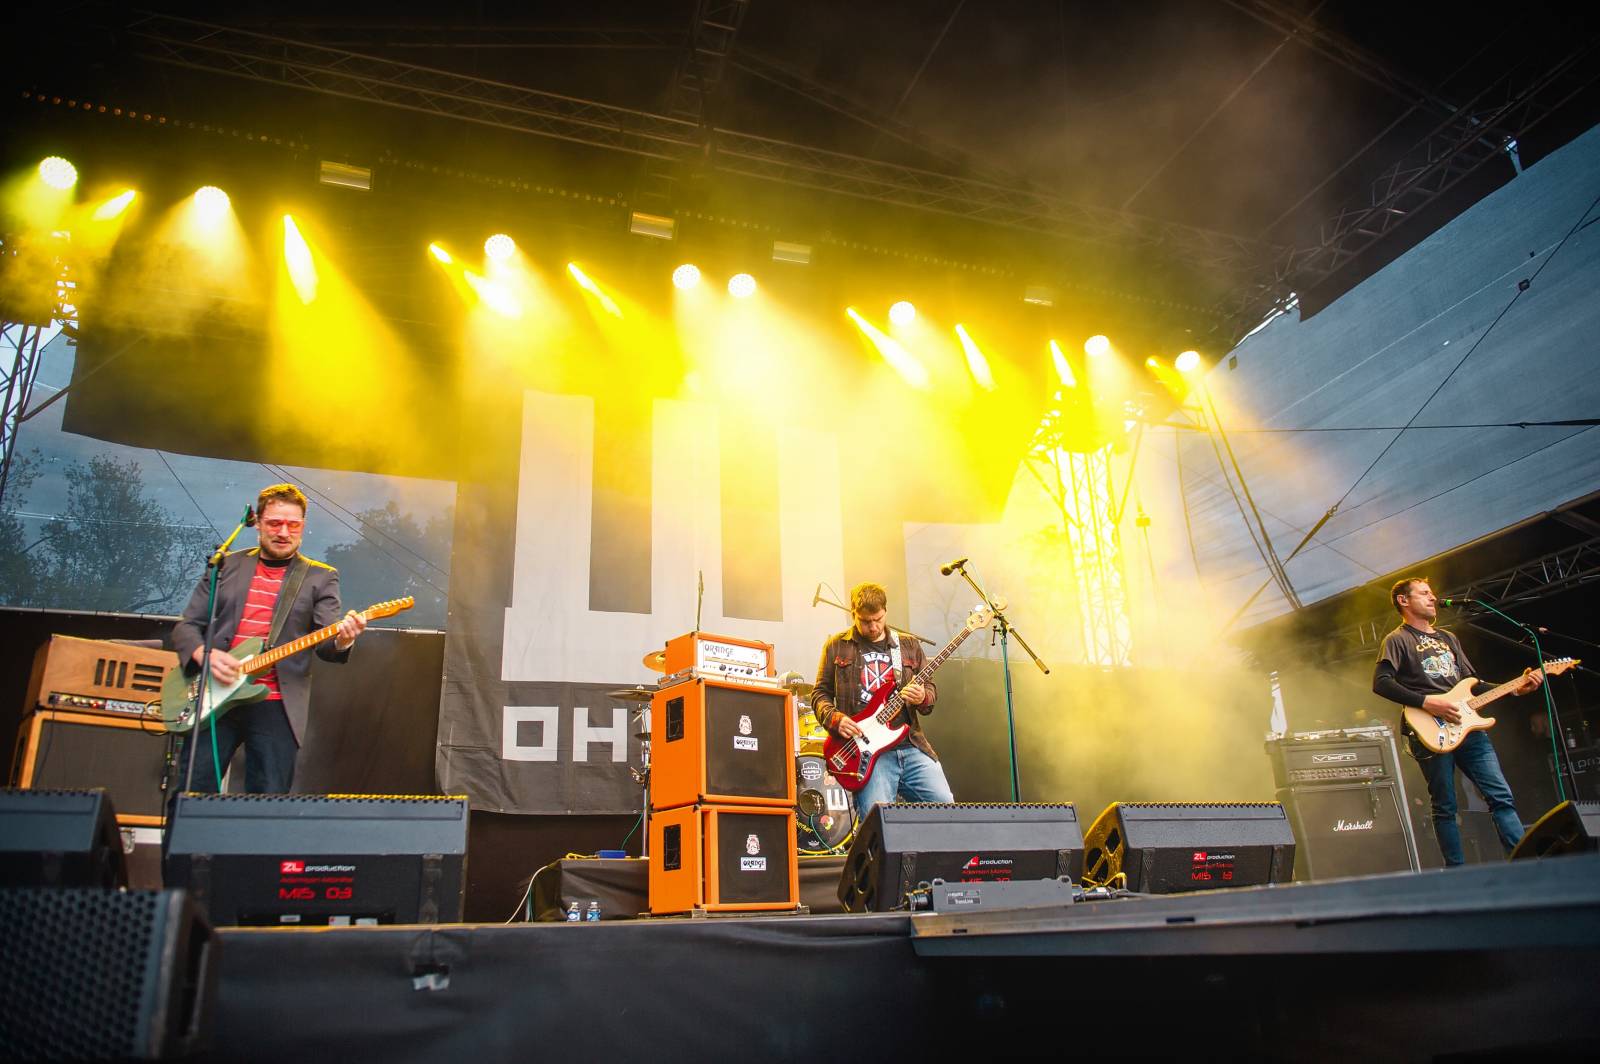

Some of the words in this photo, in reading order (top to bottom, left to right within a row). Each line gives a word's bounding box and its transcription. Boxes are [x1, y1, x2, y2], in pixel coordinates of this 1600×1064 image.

[1333, 819, 1373, 832] Marshall
[1192, 851, 1207, 861] ZL
[281, 861, 304, 872] ZL
[304, 865, 357, 873] production
[979, 859, 1013, 867] production
